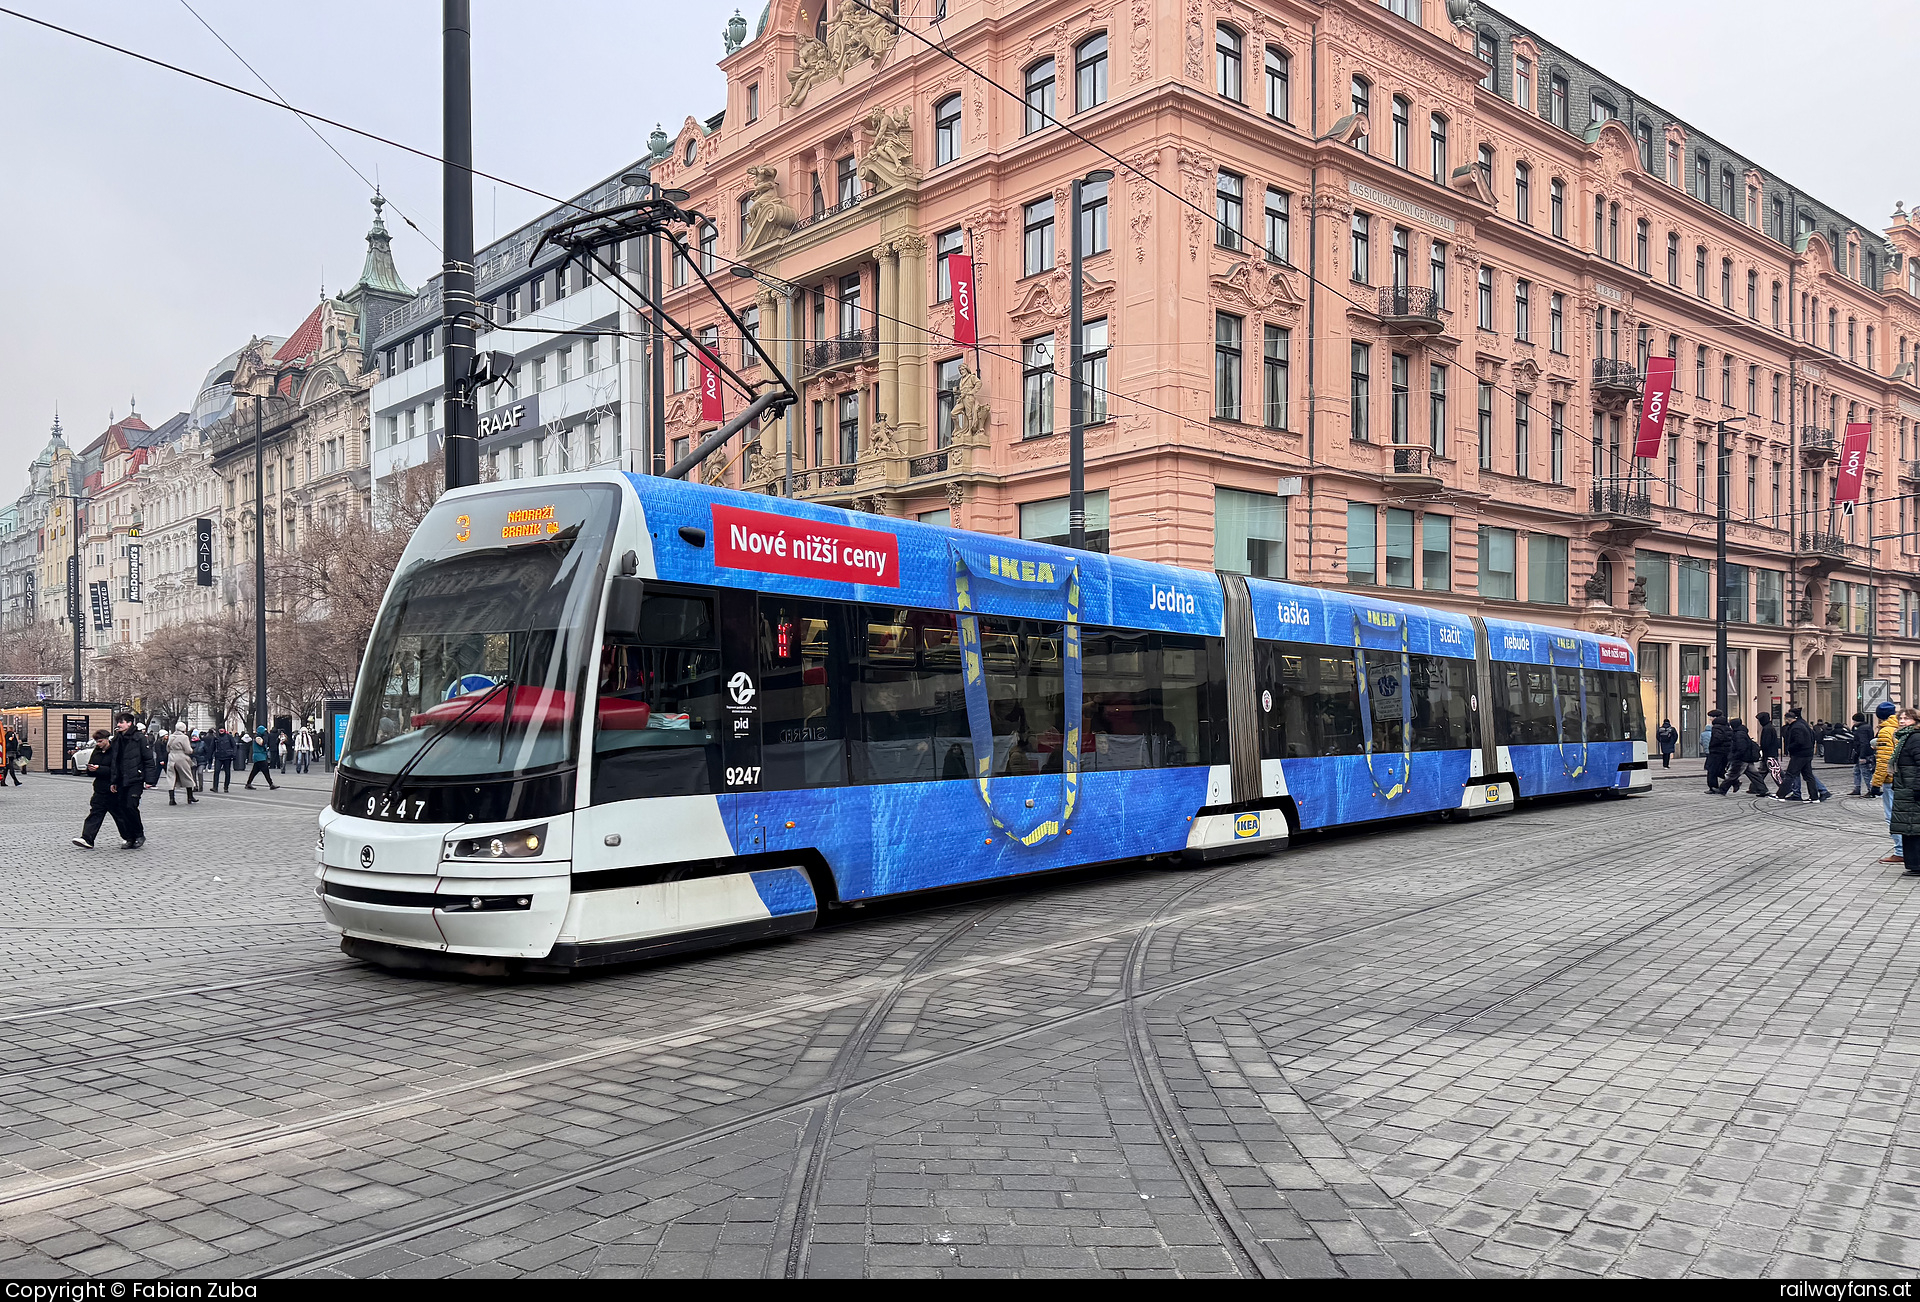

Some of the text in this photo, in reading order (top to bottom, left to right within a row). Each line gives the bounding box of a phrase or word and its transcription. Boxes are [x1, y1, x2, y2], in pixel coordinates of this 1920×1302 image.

[1353, 183, 1450, 229] ASSICURAZIONI GENERALI
[958, 281, 969, 320] AON
[1648, 391, 1664, 423] AON
[477, 405, 523, 438] RAAF
[1846, 451, 1860, 477] AON
[456, 515, 470, 542] 3
[730, 524, 887, 577] Nové nižší ceny
[989, 554, 1055, 583] IKEA
[101, 586, 110, 624] RESERVED
[1150, 584, 1194, 614] Jedna
[1278, 600, 1310, 625] taška
[1367, 609, 1396, 627] IKEA
[1440, 625, 1461, 644] stačit
[1504, 633, 1530, 650] nebude
[1557, 637, 1575, 649] IKEA
[734, 717, 749, 732] pid
[726, 767, 761, 785] 9247
[366, 797, 425, 820] 9247
[1237, 820, 1258, 831] IKEA
